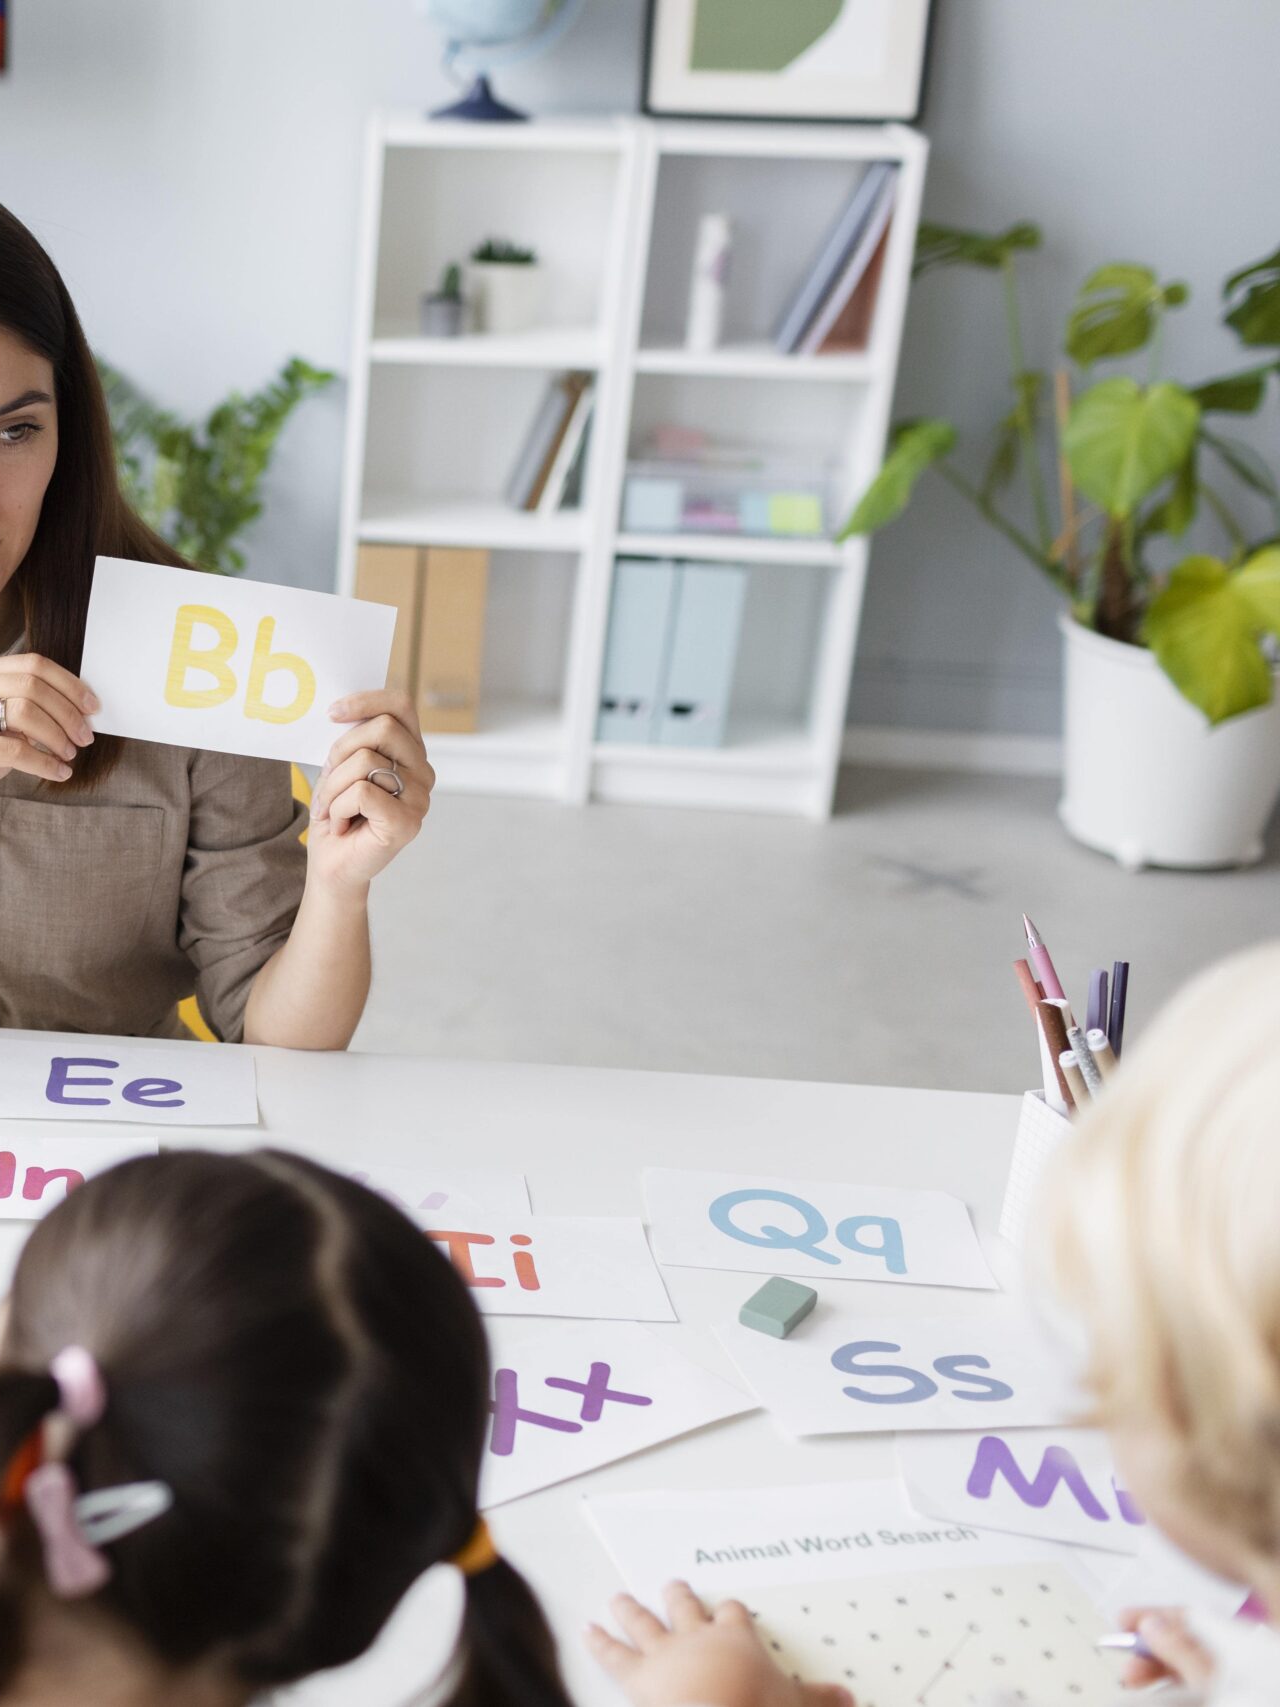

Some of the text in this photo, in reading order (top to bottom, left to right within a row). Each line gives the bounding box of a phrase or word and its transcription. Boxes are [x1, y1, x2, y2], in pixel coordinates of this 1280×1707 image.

[164, 603, 317, 725] Bb
[45, 1056, 186, 1108] Ee
[708, 1188, 907, 1275] Qq
[831, 1340, 1014, 1405] Ss
[694, 1525, 979, 1567] Animal Word Search
